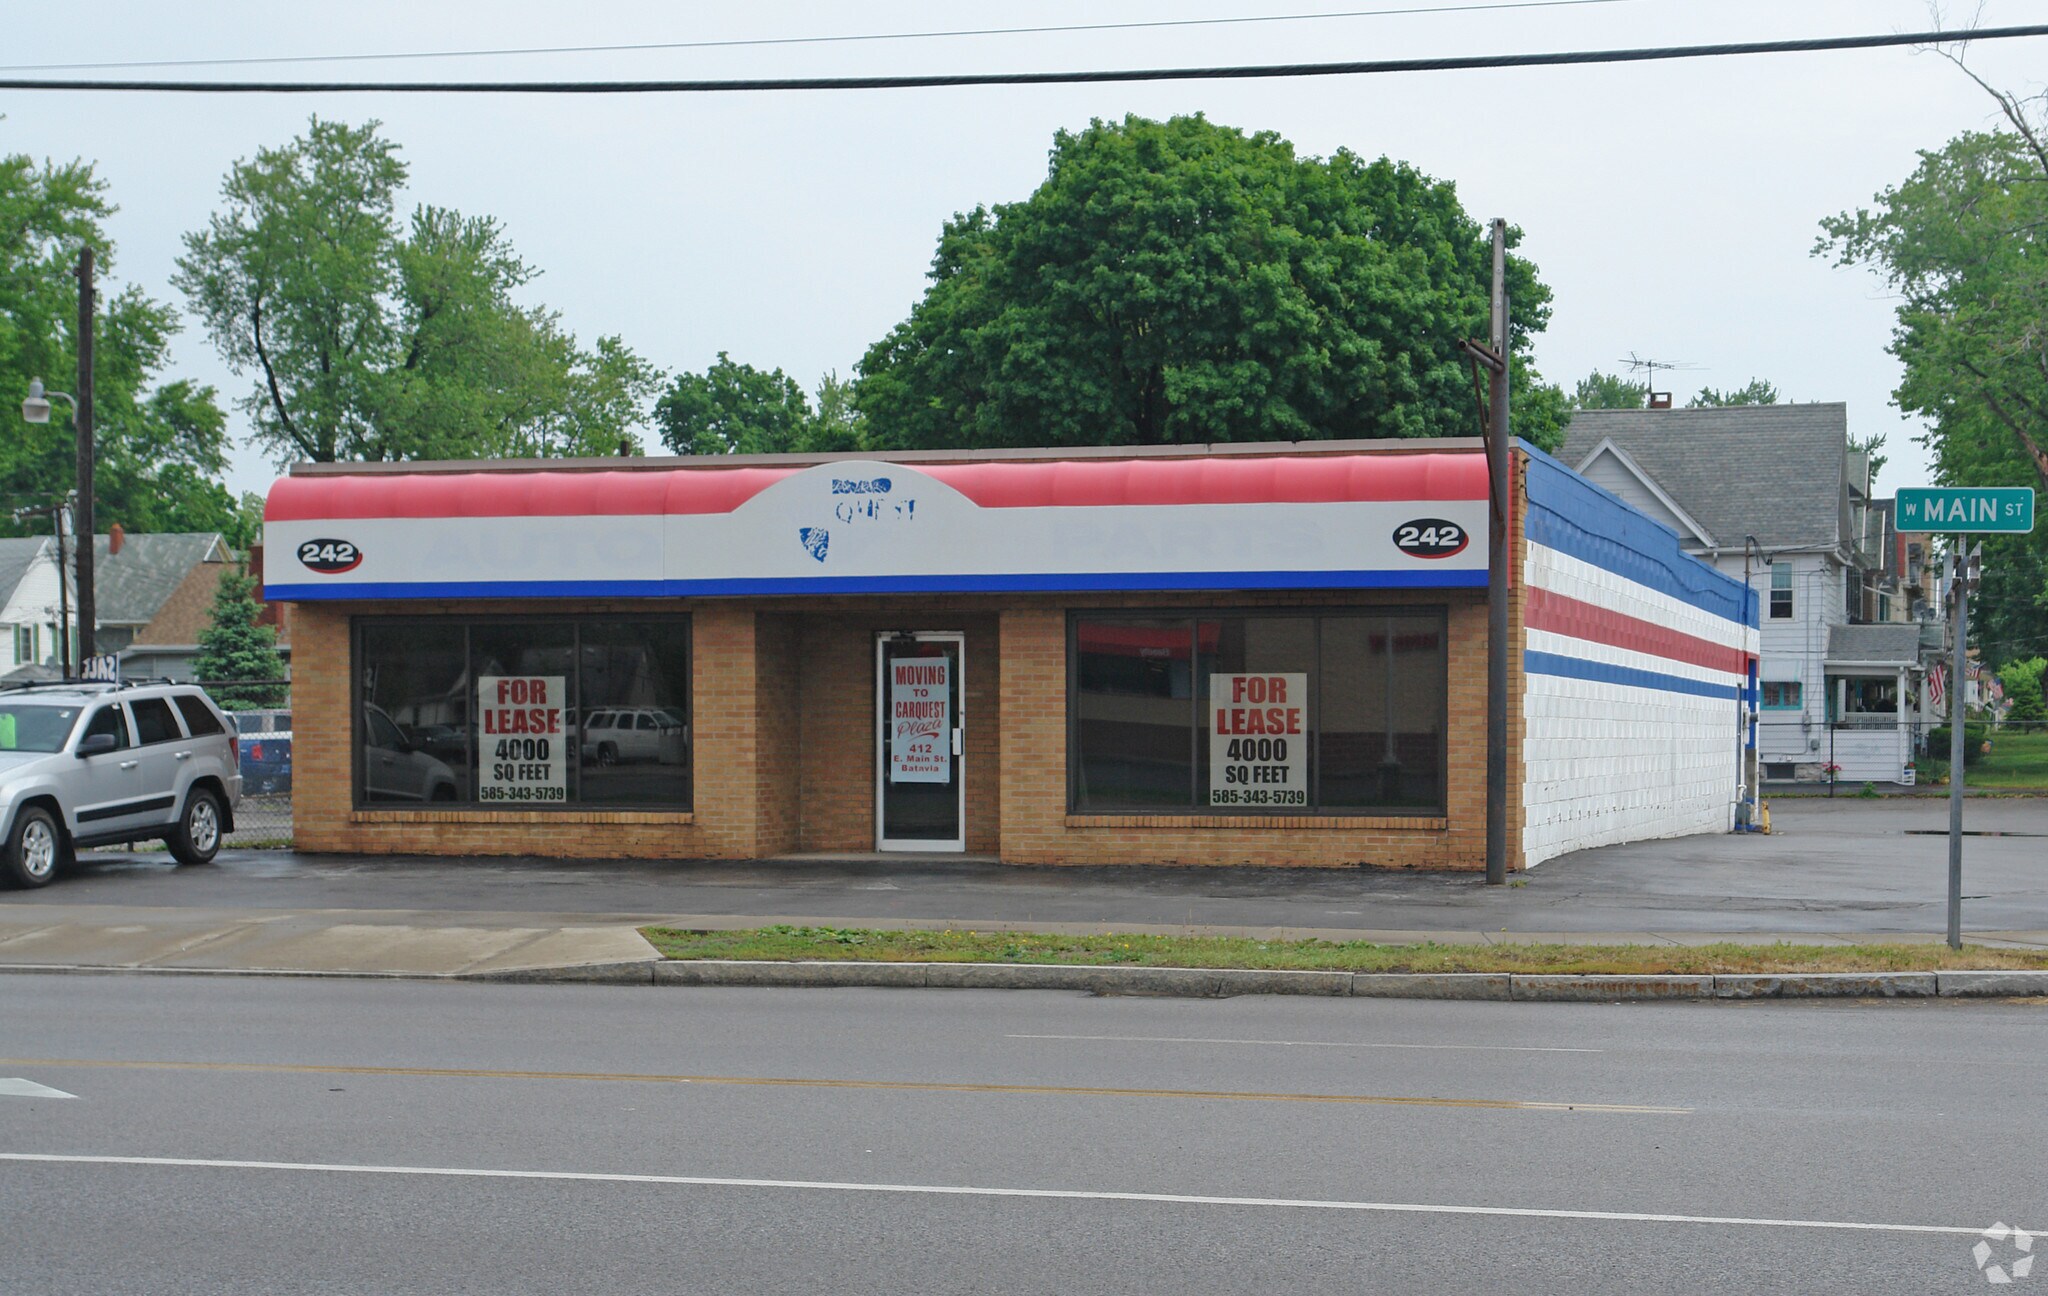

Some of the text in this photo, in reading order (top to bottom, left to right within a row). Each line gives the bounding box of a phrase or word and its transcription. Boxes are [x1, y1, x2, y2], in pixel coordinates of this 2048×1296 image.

[1905, 498, 2023, 522] W MAIN ST
[1398, 526, 1460, 546] 242
[302, 543, 354, 562] 242
[895, 665, 945, 685] MOVING
[497, 679, 547, 705] FOR
[913, 688, 928, 697] TO
[1232, 676, 1287, 703] FOR
[895, 701, 945, 719] CARQUEST
[484, 708, 561, 735] LEASE
[897, 719, 943, 738] Plaza
[1216, 707, 1301, 735] LEASE
[495, 738, 549, 761] 4000
[893, 754, 948, 762] E. Main St.
[909, 744, 932, 753] 412
[1226, 738, 1288, 762] 4000
[493, 763, 551, 782] SQ FEET
[901, 764, 939, 772] Batavia
[1225, 765, 1290, 785] SQ FEET
[481, 786, 565, 801] 585-343-5739
[1212, 789, 1305, 804] 585-343-5739
